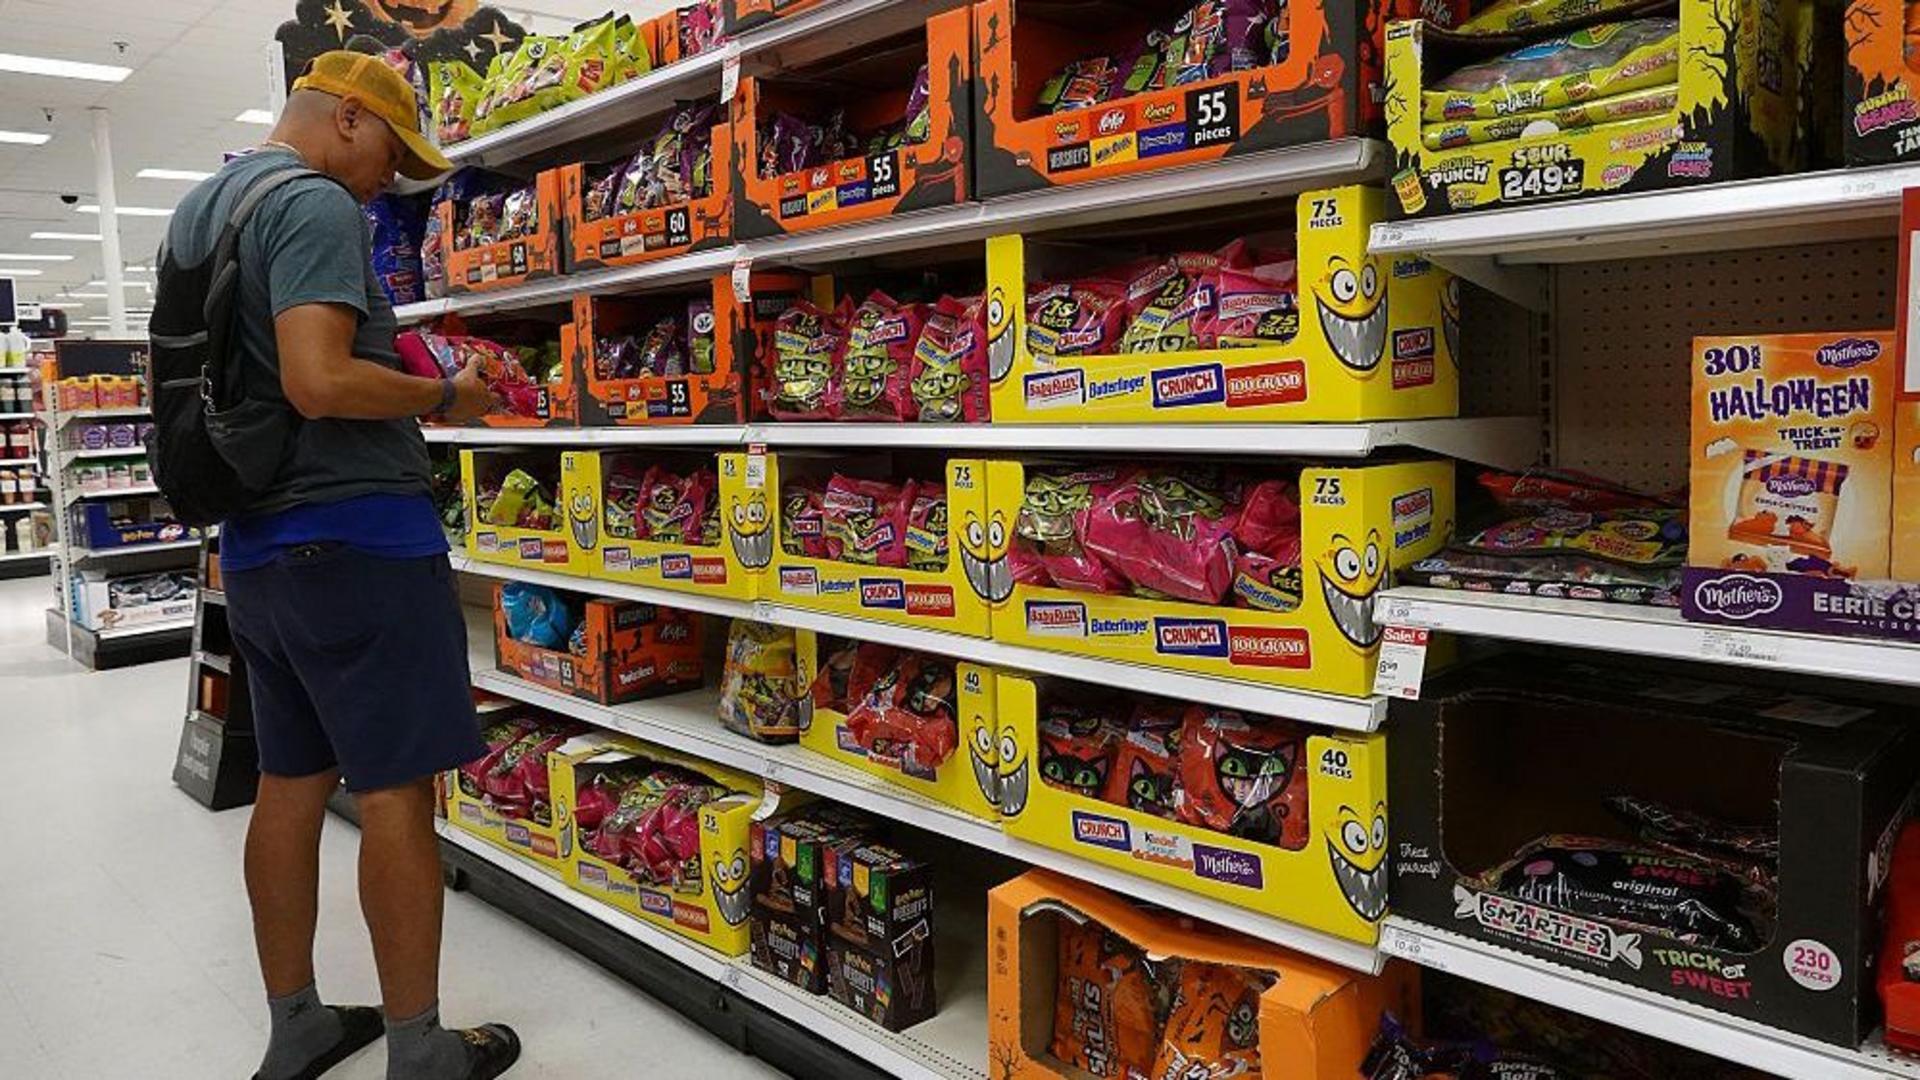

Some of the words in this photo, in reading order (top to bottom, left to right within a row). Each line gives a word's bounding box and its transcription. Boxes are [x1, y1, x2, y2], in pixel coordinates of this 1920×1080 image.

[1197, 90, 1227, 126] 55
[1194, 126, 1231, 144] pieces
[1513, 144, 1568, 167] SOUR
[873, 156, 892, 183] 55
[1430, 166, 1488, 188] PUNCH
[1504, 166, 1578, 197] 249+
[872, 184, 895, 199] pieces
[1312, 199, 1336, 217] 75
[670, 212, 685, 233] 60
[1310, 217, 1342, 229] PIECES
[1704, 345, 1750, 376] 30
[671, 384, 685, 403] 55
[1090, 376, 1146, 399] Butterfinger
[1160, 373, 1214, 398] CRUNCH
[1710, 378, 1869, 422] HALLOWEEN
[1793, 437, 1842, 450] TREAT
[955, 467, 970, 481] 75
[1315, 478, 1340, 495] 75
[1313, 495, 1346, 506] PIECES
[864, 587, 898, 600] CRUNCH
[1702, 584, 1777, 607] Mother's
[1813, 591, 1886, 617] EERIE
[1091, 617, 1149, 635] Butterfinger
[1163, 626, 1217, 644] CRUNCH
[1383, 628, 1416, 643] Sale!
[964, 672, 980, 687] 40
[1322, 750, 1348, 767] 40
[1320, 766, 1353, 780] PIECES
[1079, 819, 1122, 839] CRUNCH
[1201, 854, 1254, 876] Mother's
[1612, 880, 1680, 897] original
[1484, 902, 1602, 949] SMARTIES
[1653, 948, 1723, 975] TRICK
[1793, 948, 1830, 970] 230
[1791, 965, 1833, 983] PIECES
[1670, 971, 1751, 999] SWEET
